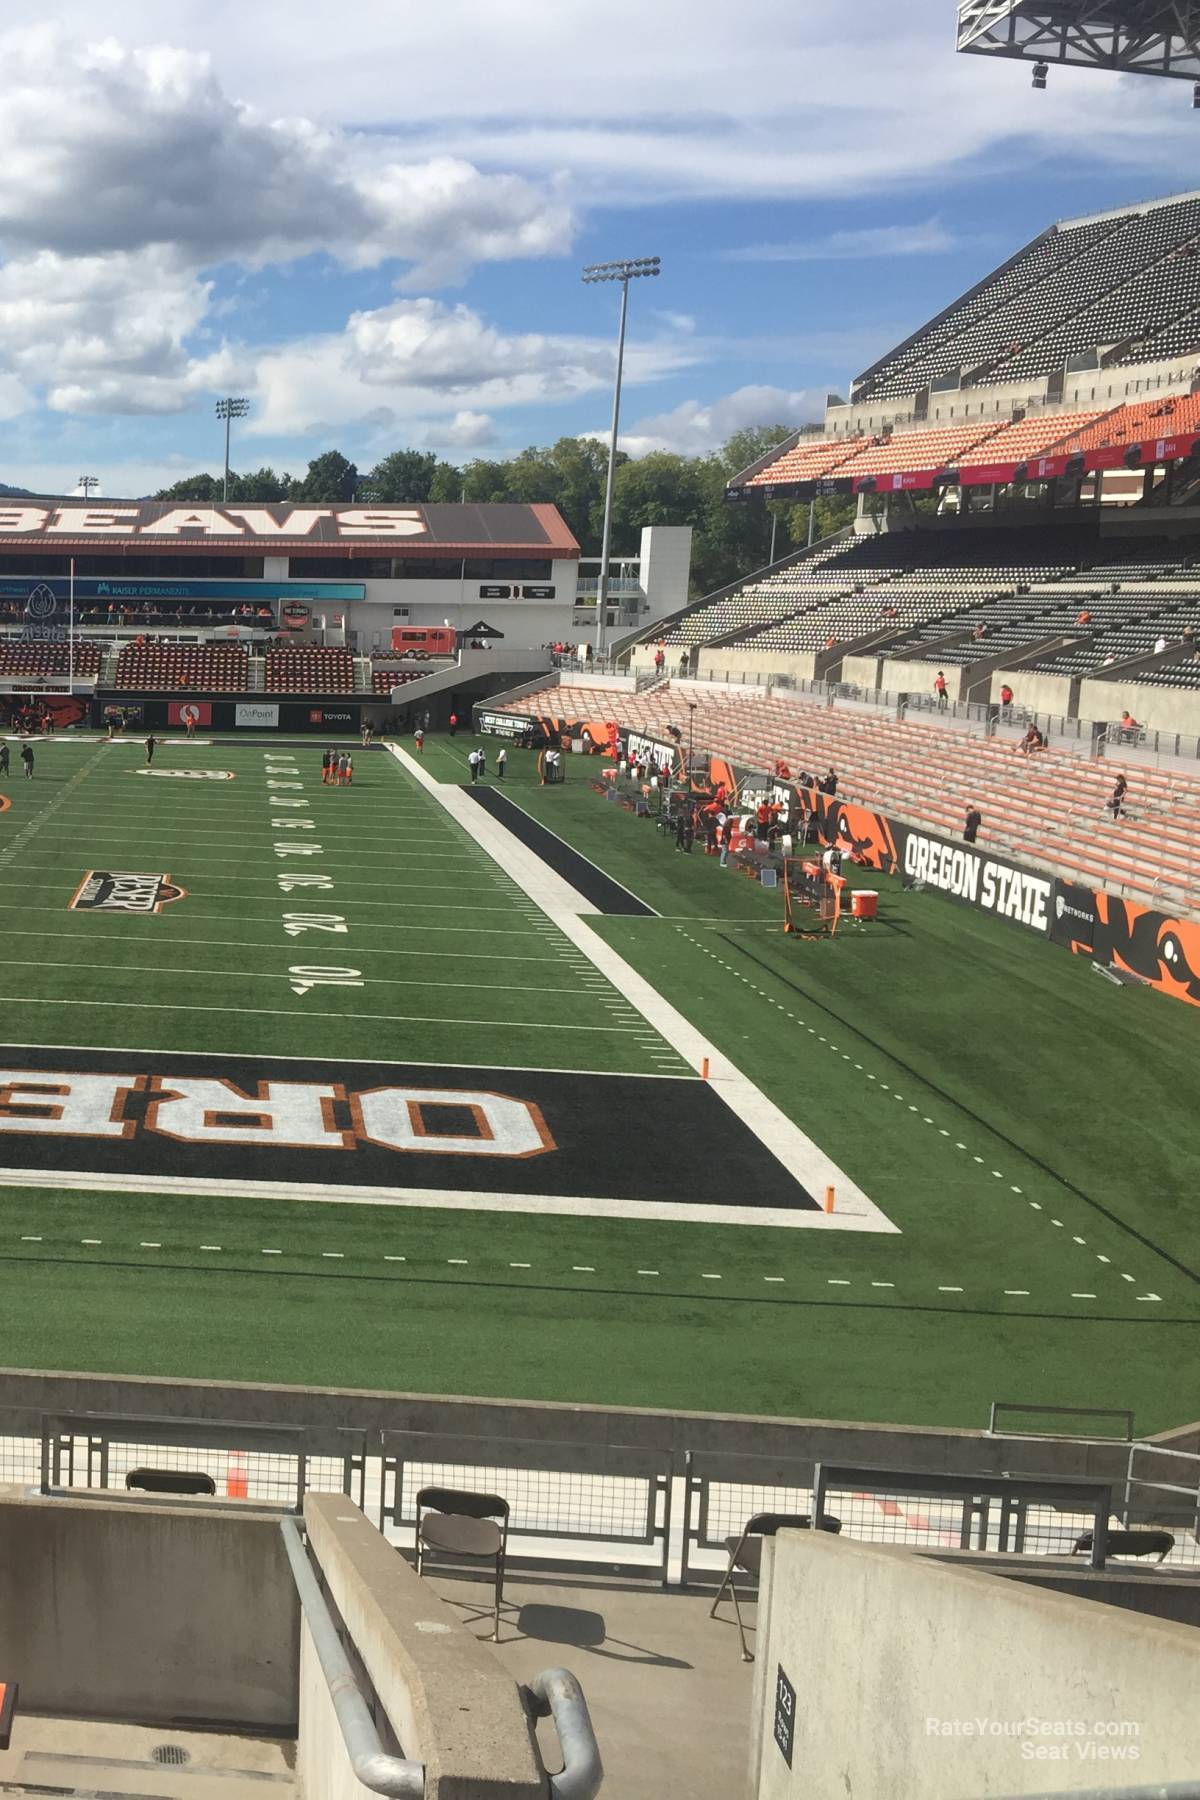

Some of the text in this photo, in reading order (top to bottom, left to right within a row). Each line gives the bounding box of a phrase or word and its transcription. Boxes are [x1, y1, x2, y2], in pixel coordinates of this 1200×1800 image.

[112, 586, 191, 595] KAISER PERMANENTE
[239, 708, 273, 719] OnPoint
[323, 713, 352, 721] TOYOTA
[277, 873, 335, 889] 30
[904, 832, 1051, 931] OREGON STATE
[94, 873, 162, 911] RESER
[1064, 904, 1094, 922] NETWORKS
[282, 913, 349, 934] 20
[288, 965, 365, 987] 10
[779, 1679, 792, 1716] 123
